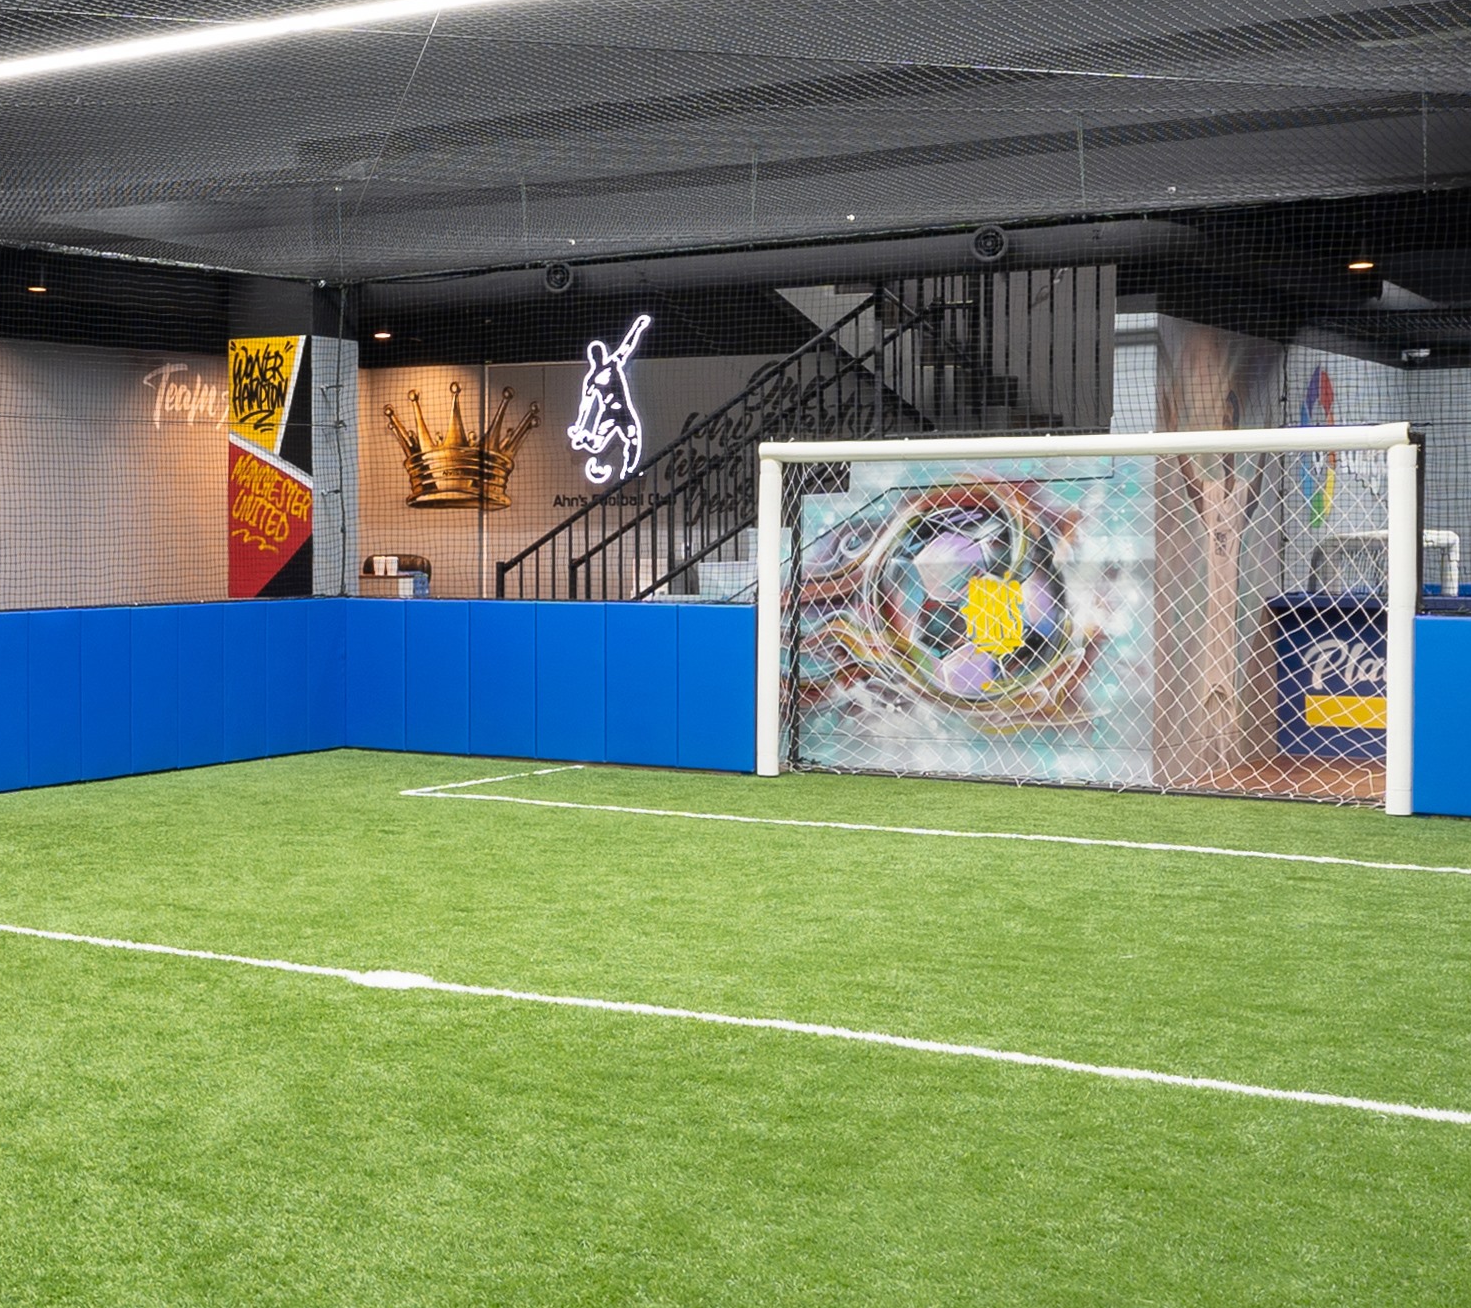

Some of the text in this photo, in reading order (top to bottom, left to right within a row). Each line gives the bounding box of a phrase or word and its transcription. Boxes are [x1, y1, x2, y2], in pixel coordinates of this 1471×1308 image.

[232, 489, 290, 543] UNITED
[553, 494, 588, 507] Ahn's
[1303, 638, 1387, 690] Pla
